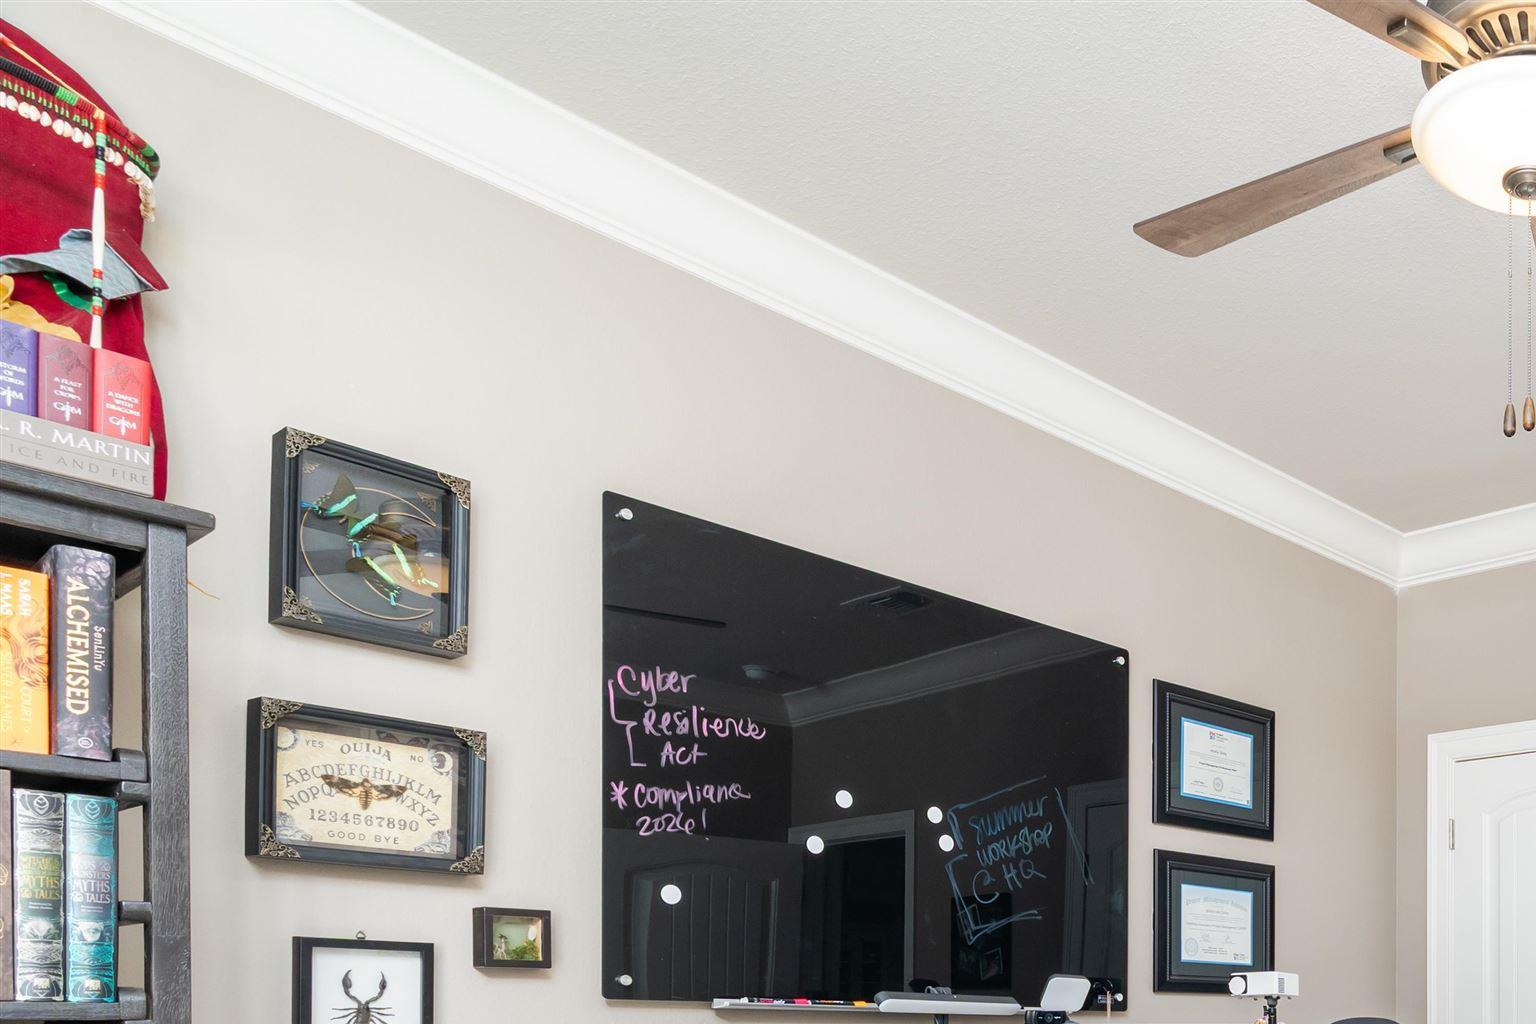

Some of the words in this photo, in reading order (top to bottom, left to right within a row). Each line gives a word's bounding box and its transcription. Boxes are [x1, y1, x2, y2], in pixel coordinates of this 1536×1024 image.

[52, 428, 150, 465] MARTIN
[10, 443, 43, 460] ICE
[55, 456, 100, 474] AND
[111, 468, 149, 486] FIRE
[18, 578, 31, 616] SARAH
[66, 576, 90, 716] ALCHEMISED
[616, 665, 697, 707] Cyber
[304, 738, 324, 749] YES
[340, 742, 393, 762] OUIJA
[660, 740, 708, 768] Act
[410, 753, 425, 764] NO
[308, 808, 420, 832] 1234567890
[327, 830, 366, 842] GOOD
[374, 834, 400, 845] BYE
[72, 879, 110, 894] MYTHS
[86, 893, 111, 904] TALES
